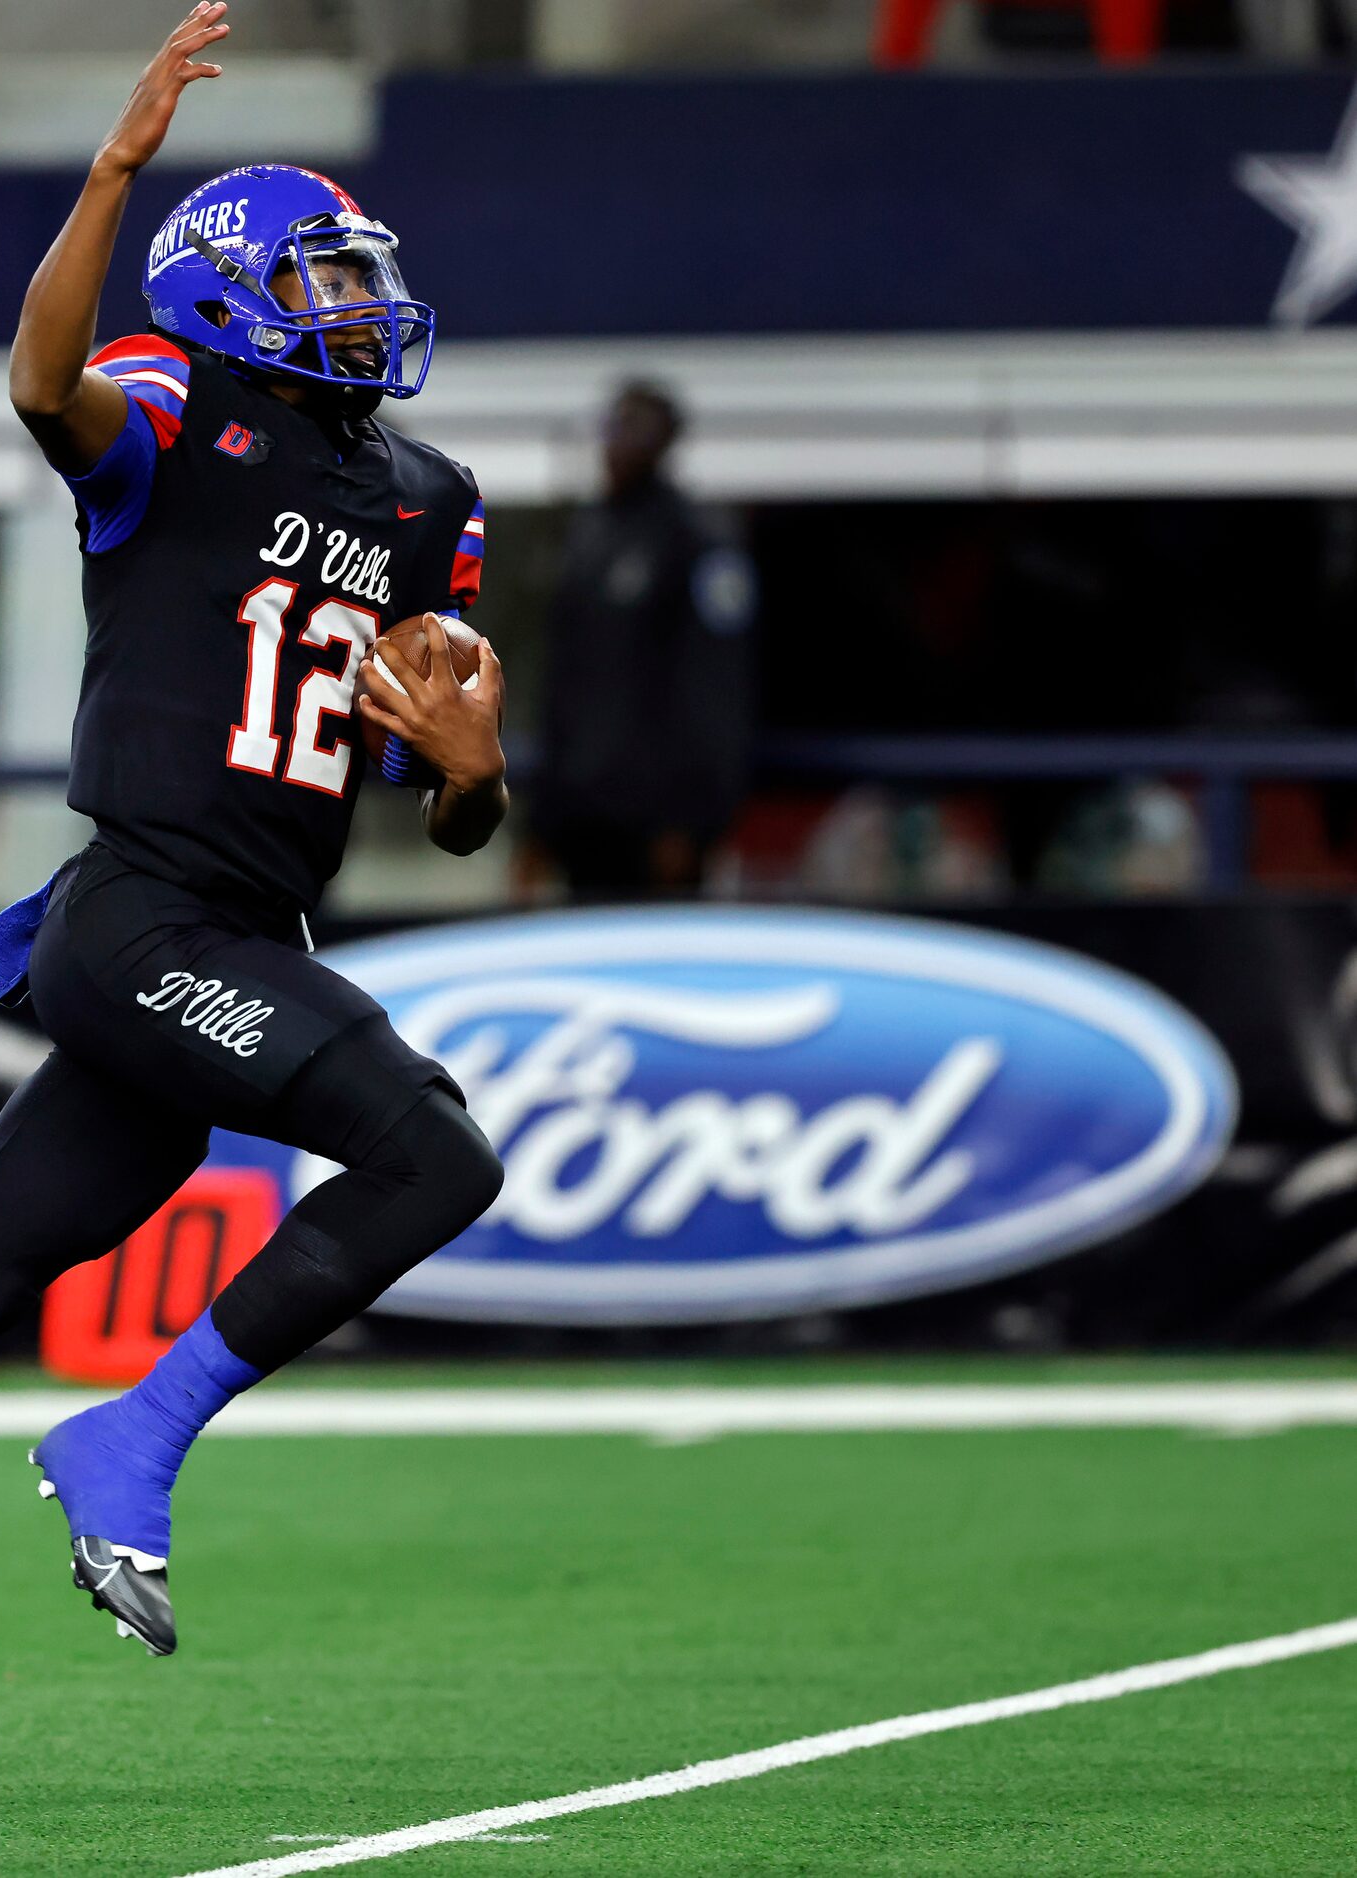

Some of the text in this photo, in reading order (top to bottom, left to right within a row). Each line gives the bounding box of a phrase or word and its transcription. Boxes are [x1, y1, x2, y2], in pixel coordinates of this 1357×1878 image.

[149, 198, 249, 270] PANTHERS
[214, 420, 254, 457] D
[259, 511, 391, 604] D'Ville
[227, 576, 380, 798] 12
[136, 971, 275, 1057] D'Ville
[332, 976, 1003, 1243] Ford
[100, 1203, 227, 1339] 10
